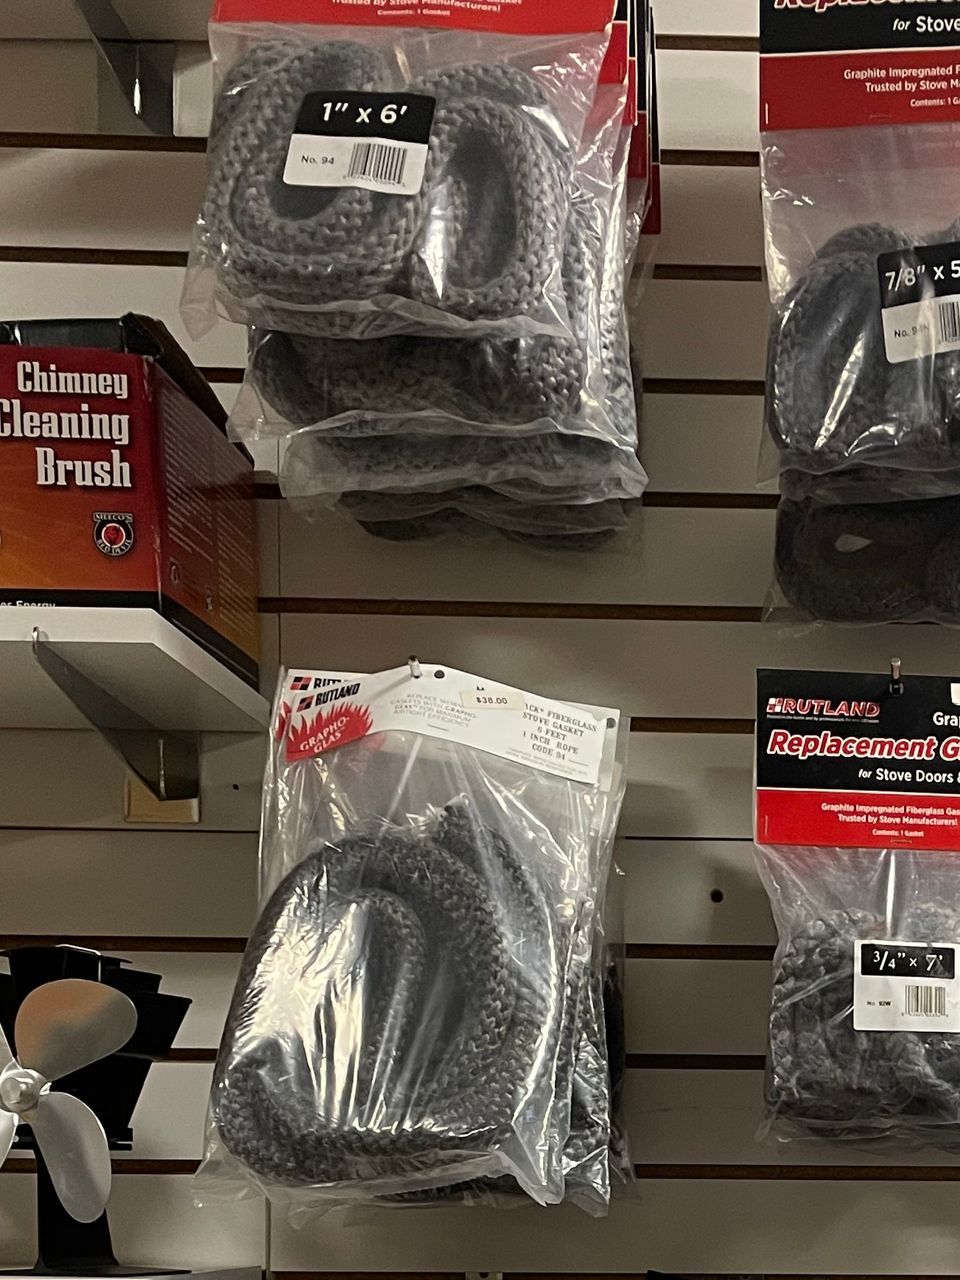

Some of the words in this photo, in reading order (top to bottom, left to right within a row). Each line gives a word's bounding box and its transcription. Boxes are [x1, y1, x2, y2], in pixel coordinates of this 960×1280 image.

[892, 18, 912, 32] for
[844, 65, 886, 81] Graphite
[889, 64, 954, 80] Impregnated
[321, 101, 348, 122] 1"
[355, 108, 371, 124] x
[381, 102, 408, 124] 6'
[320, 153, 336, 165] 94
[885, 264, 927, 292] 7/8"
[932, 266, 945, 281] x
[17, 361, 129, 399] Chimney
[0, 399, 130, 445] Cleaning
[35, 447, 132, 488] Brush
[314, 683, 361, 706] RUTLAND
[782, 698, 880, 718] RUTLAND
[766, 729, 937, 760] Replacement
[858, 768, 872, 779] for
[876, 768, 912, 782] Stove
[916, 770, 954, 784] Doors
